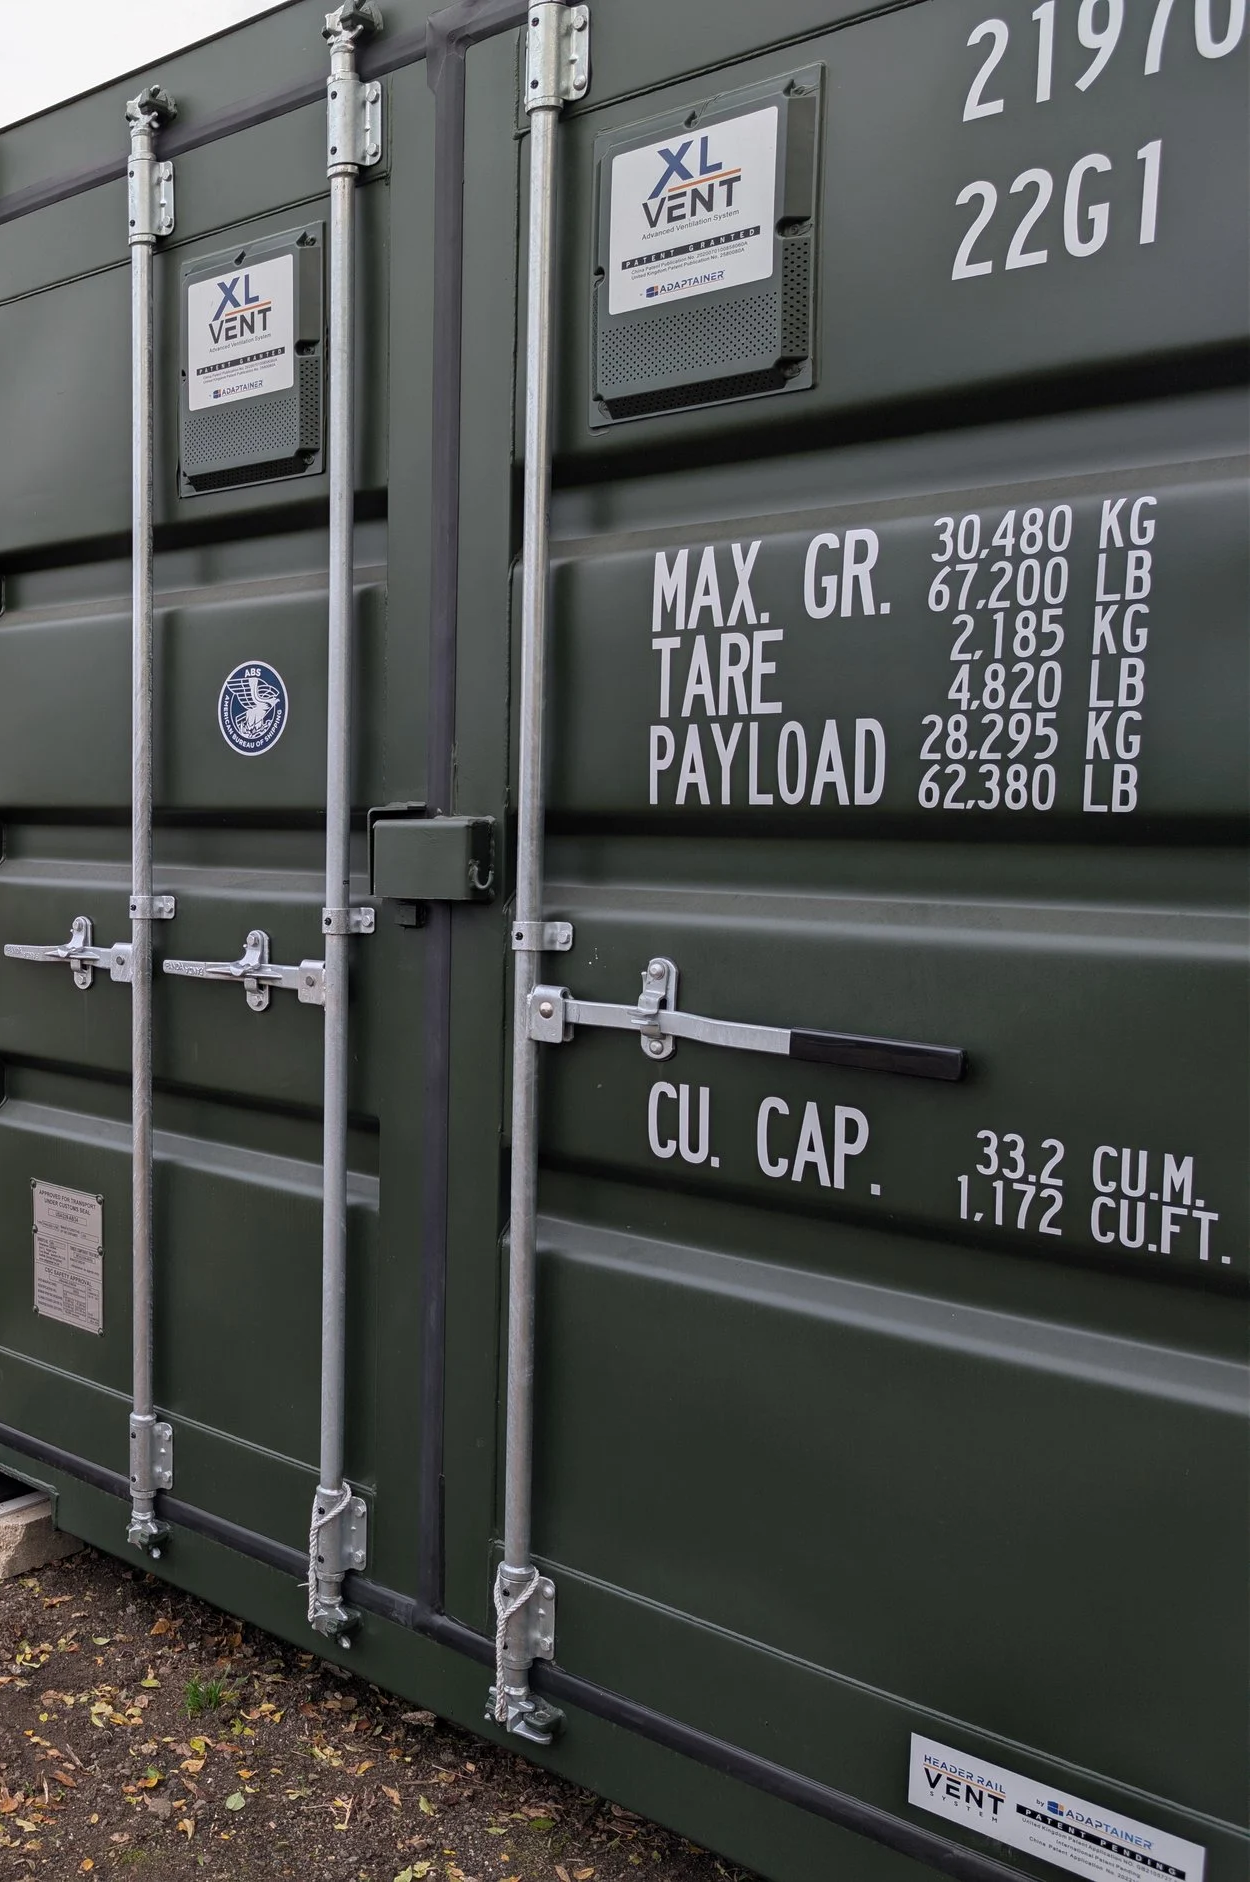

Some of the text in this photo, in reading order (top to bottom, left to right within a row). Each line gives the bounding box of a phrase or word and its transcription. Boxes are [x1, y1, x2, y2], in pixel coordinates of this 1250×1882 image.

[647, 135, 722, 200] XL
[642, 175, 741, 229] VENT
[642, 209, 740, 241] Advanced Ventilation System
[952, 139, 1163, 280] 22G1
[625, 249, 675, 269] PATENT
[688, 230, 755, 252] GRANTED
[212, 273, 260, 321] XL
[659, 270, 725, 294] ADAPTAINER
[208, 306, 272, 344] VENT
[930, 496, 1158, 564] 30,480 KG
[651, 528, 892, 632] MAX. GR.
[927, 550, 1151, 613] 67,200 LB
[950, 604, 1149, 661] 2,185 KG
[245, 668, 262, 678] ABS
[651, 629, 784, 719] TARE
[948, 657, 1145, 712] 4,820 LB
[231, 734, 255, 748] BUREAU
[256, 739, 264, 748] OF
[264, 709, 282, 742] SHIPPING
[920, 710, 1142, 762] 28,295 KG
[649, 718, 886, 806] PAYLOAD
[917, 762, 1139, 813] 62,380 LB
[648, 1081, 881, 1196] CU. CAP.
[975, 1129, 1205, 1208] 33.2 CU.M.
[957, 1174, 1231, 1265] 1,172 CU.FT.
[924, 1754, 1006, 1794] HEADER RAIL
[924, 1767, 1005, 1815] VENT
[1025, 1809, 1087, 1839] PATENT
[1100, 1839, 1177, 1876] PENDING
[1065, 1809, 1152, 1850] ADAPTAINER
